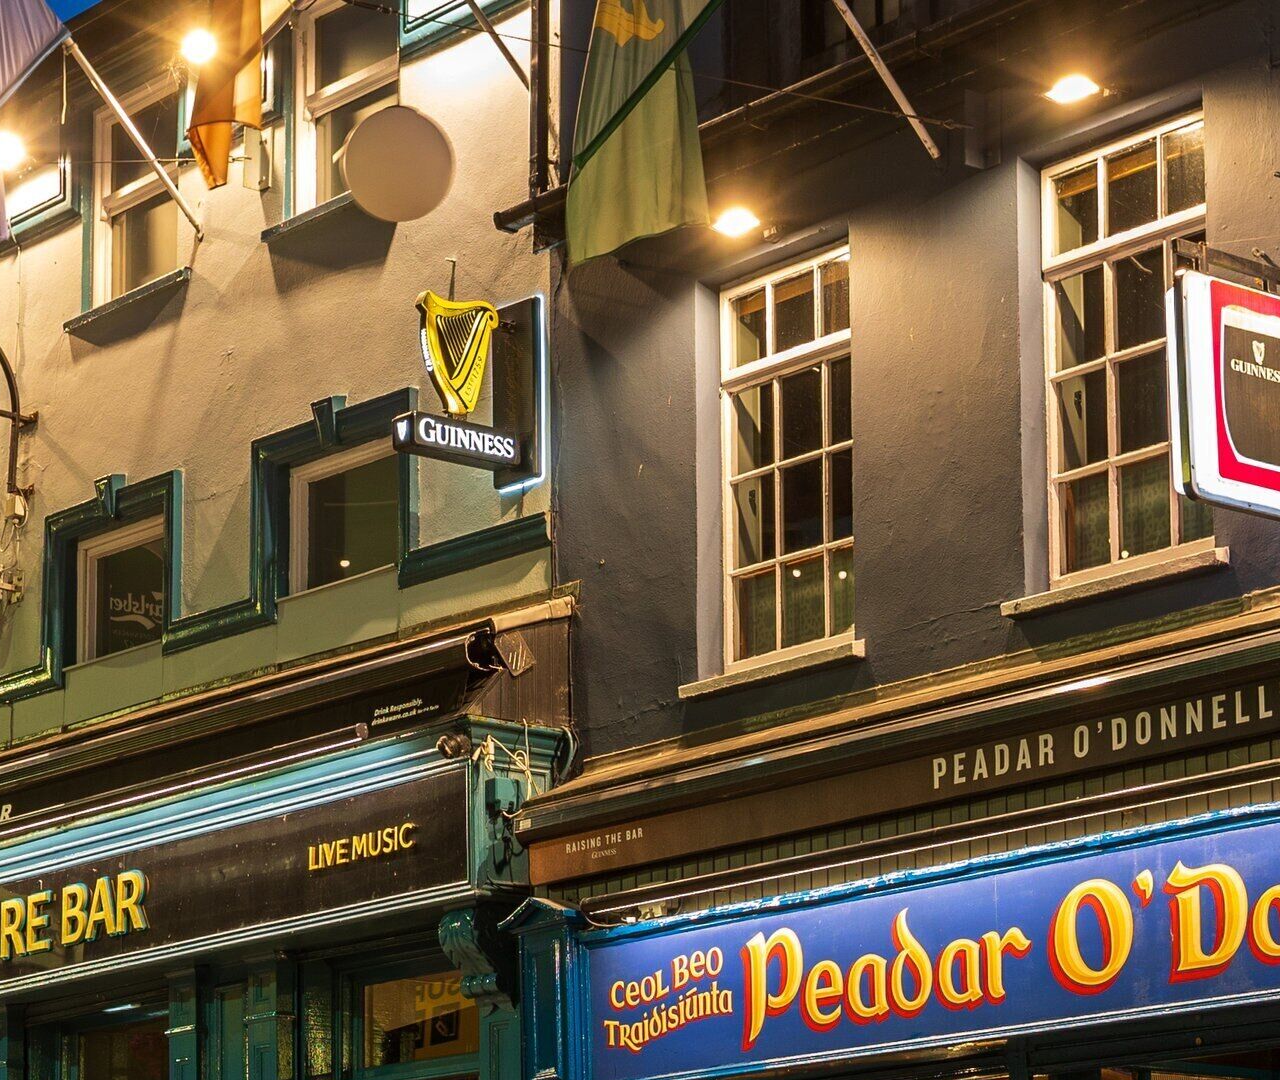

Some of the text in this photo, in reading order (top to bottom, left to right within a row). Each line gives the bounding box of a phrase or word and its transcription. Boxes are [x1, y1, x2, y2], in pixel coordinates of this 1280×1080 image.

[419, 417, 514, 459] GUINNESS
[374, 706, 390, 717] Drink
[932, 736, 1055, 790] PEADAR
[307, 823, 416, 871] LIVE MUSIC
[565, 827, 643, 854] RAISING THE BAR
[61, 868, 150, 948] BAR
[741, 925, 1032, 1052] Peadar
